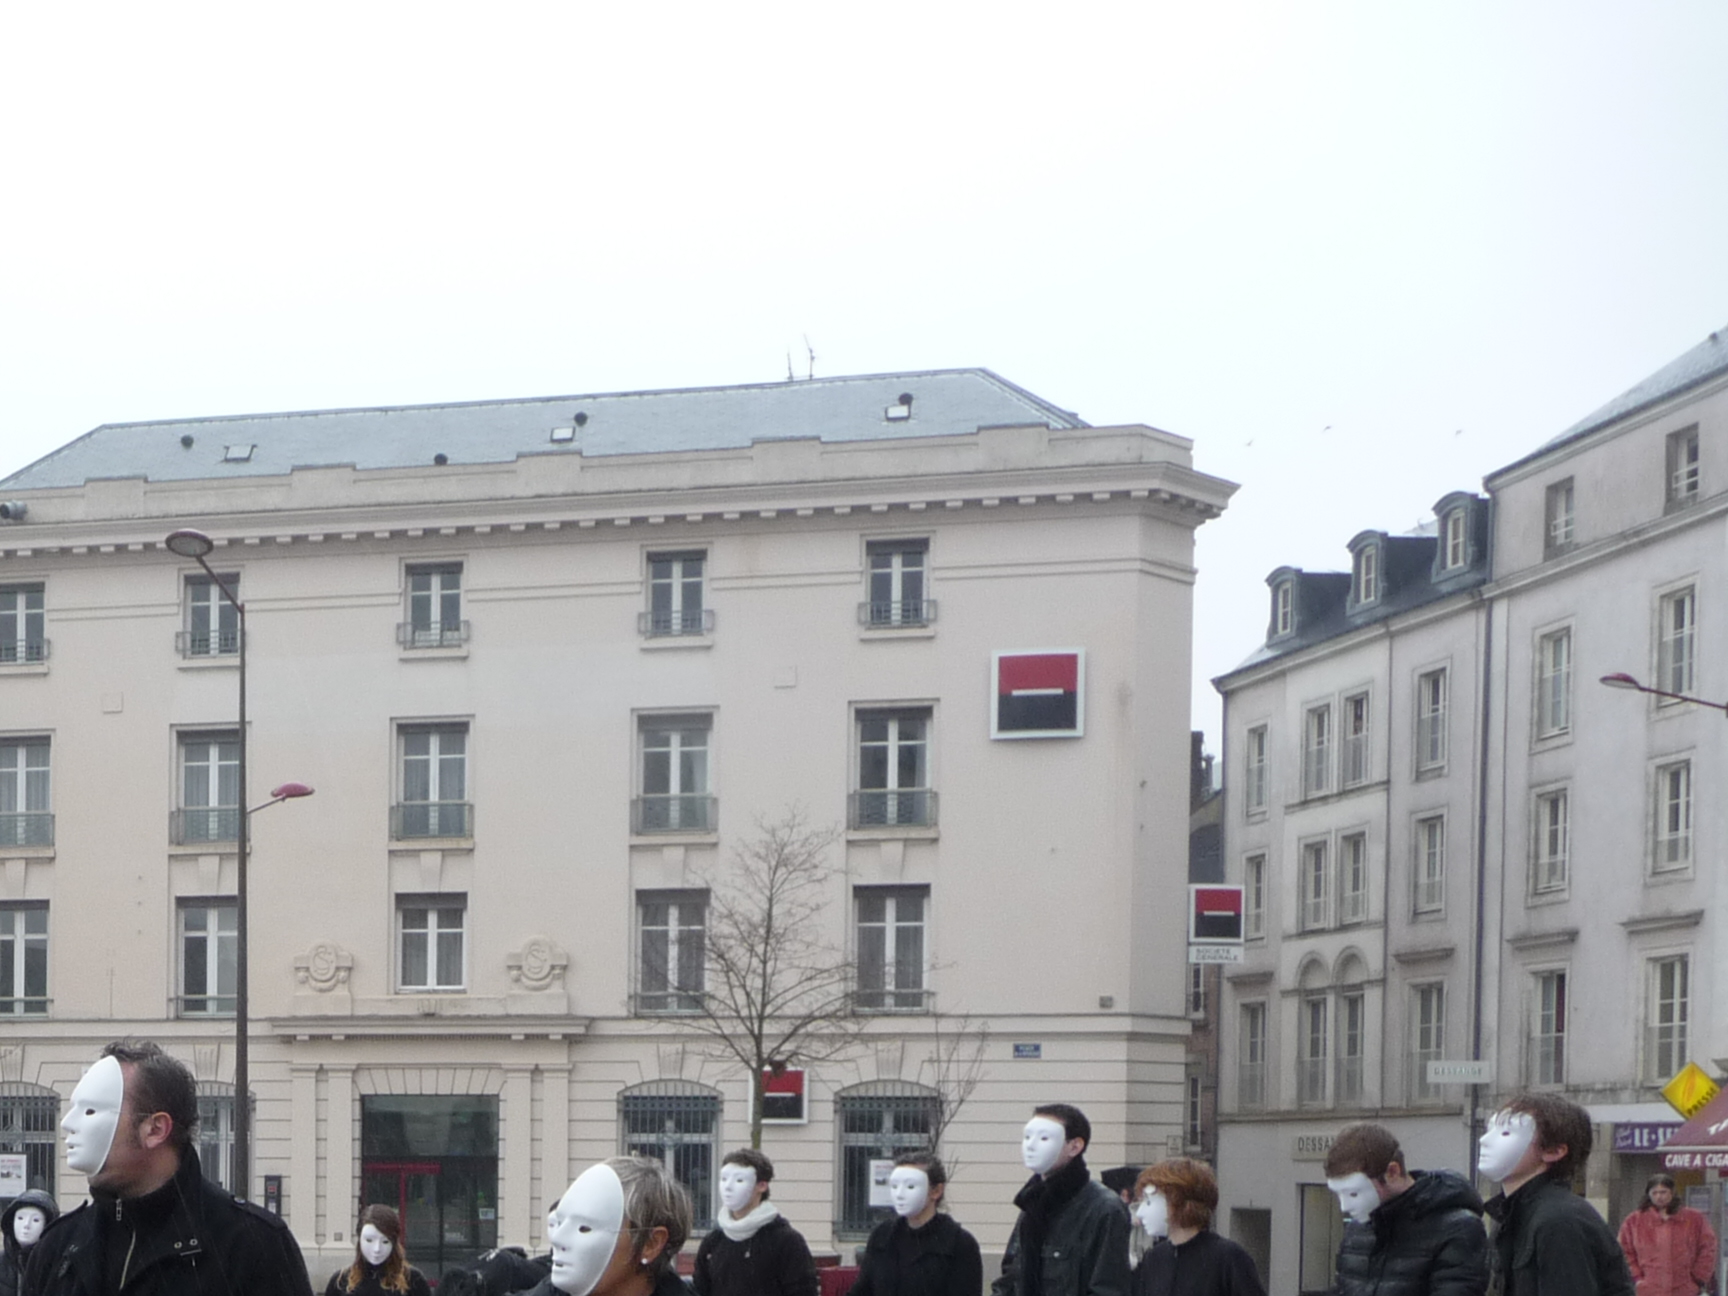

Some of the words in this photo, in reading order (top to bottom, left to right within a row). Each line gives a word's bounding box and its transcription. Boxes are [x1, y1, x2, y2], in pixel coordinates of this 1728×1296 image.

[1434, 1067, 1483, 1076] DESSANGE
[1665, 1154, 1691, 1168] CAVE
[1693, 1154, 1702, 1168] A
